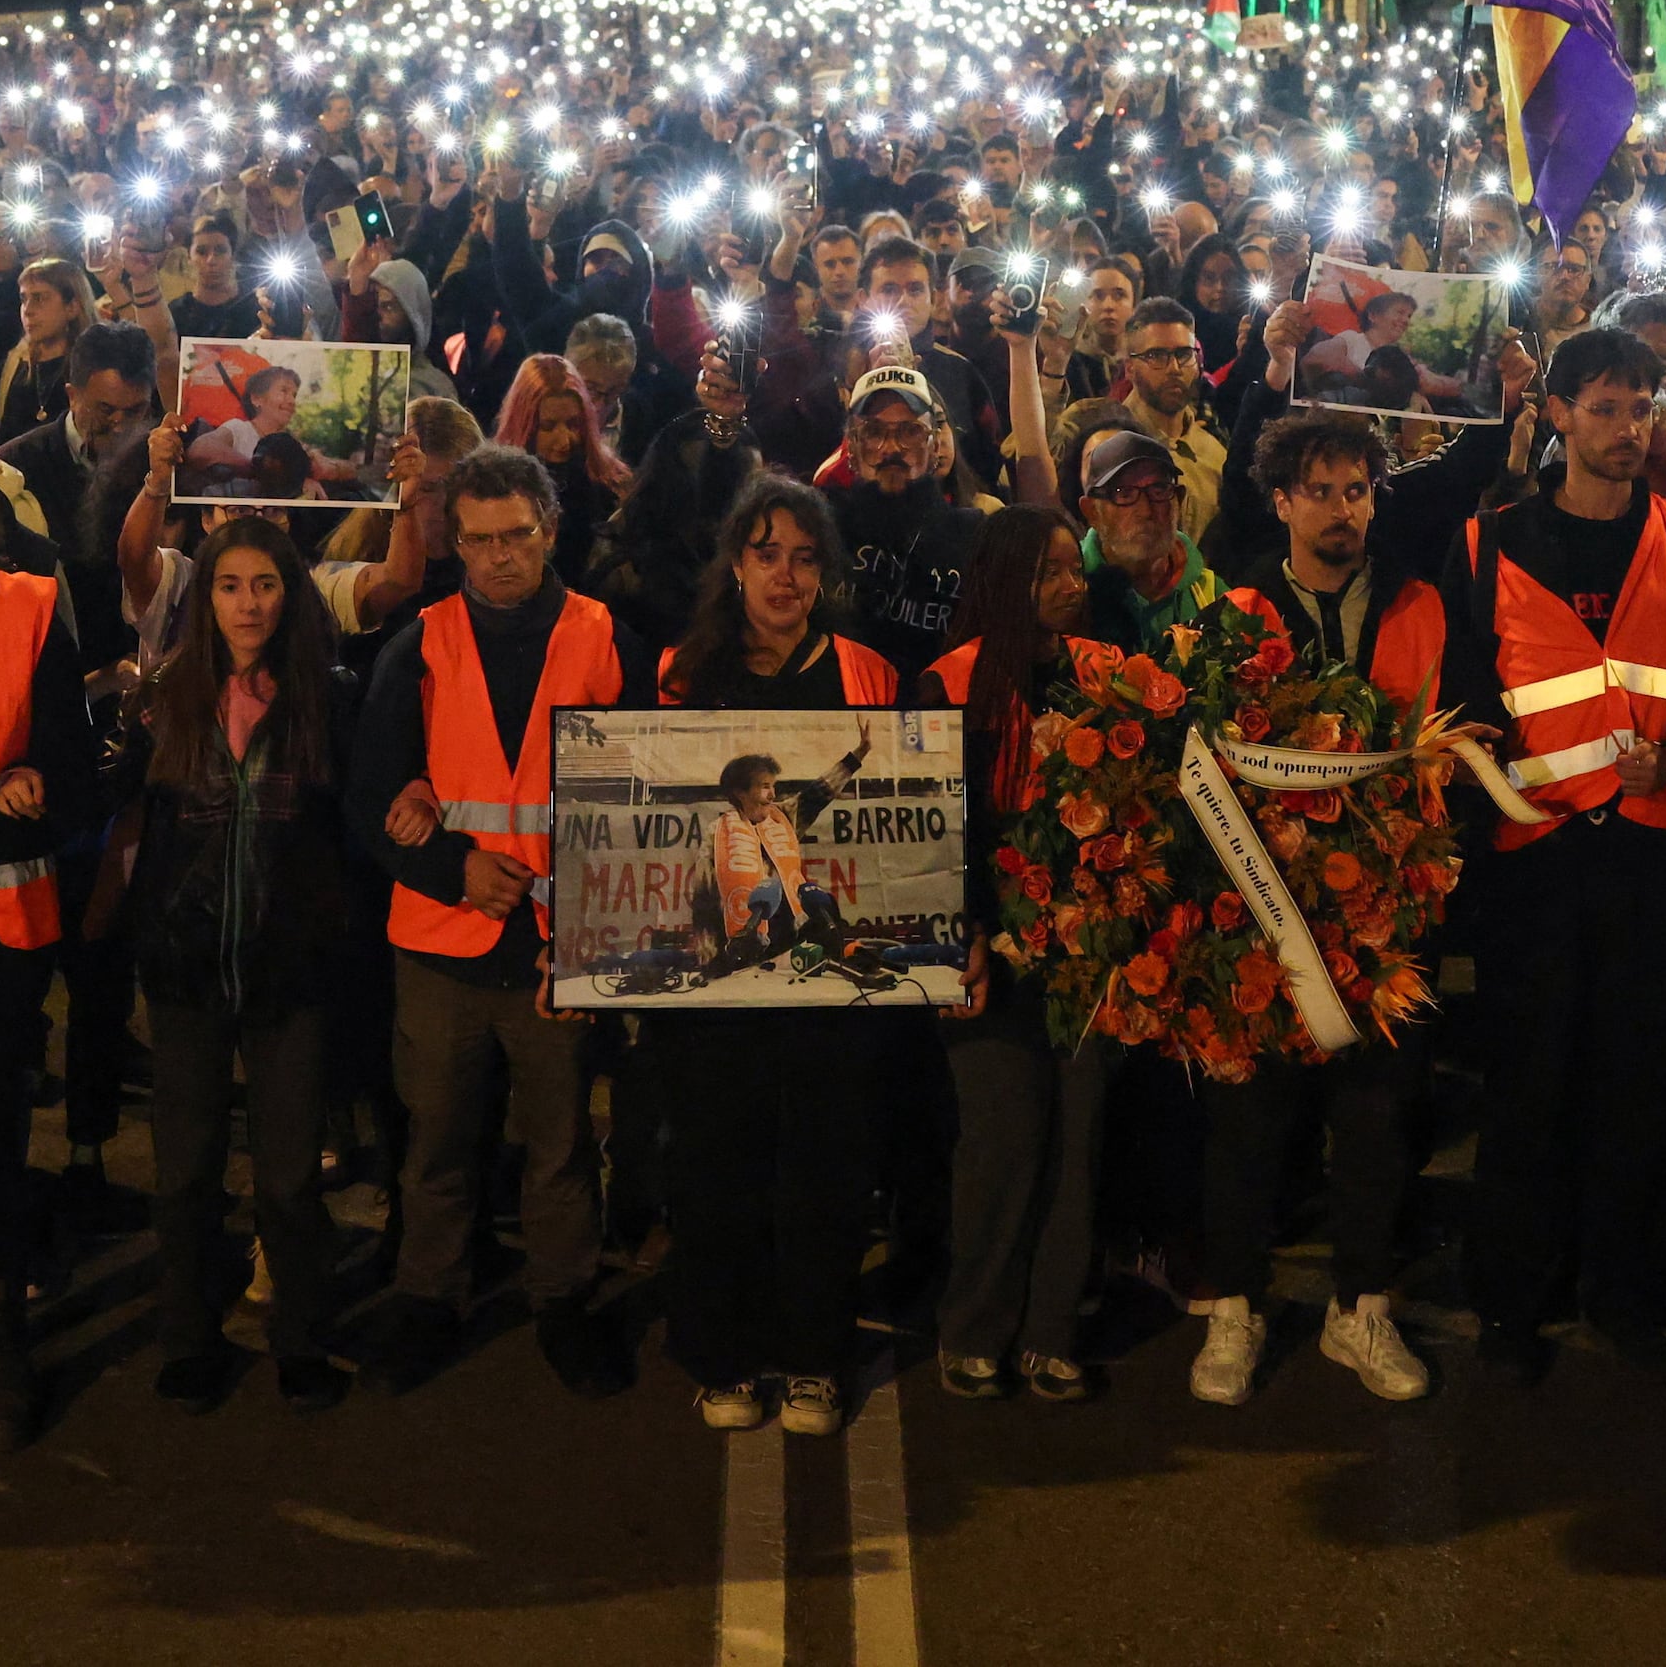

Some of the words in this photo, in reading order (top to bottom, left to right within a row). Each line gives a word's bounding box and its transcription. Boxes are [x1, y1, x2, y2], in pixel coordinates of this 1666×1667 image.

[1240, 755, 1269, 770] por
[1274, 762, 1353, 778] luchando
[1186, 756, 1202, 781] Te
[1196, 782, 1230, 837] quiere,
[1229, 836, 1244, 857] tu
[633, 812, 703, 850] VIDA
[833, 806, 947, 845] BARRIO
